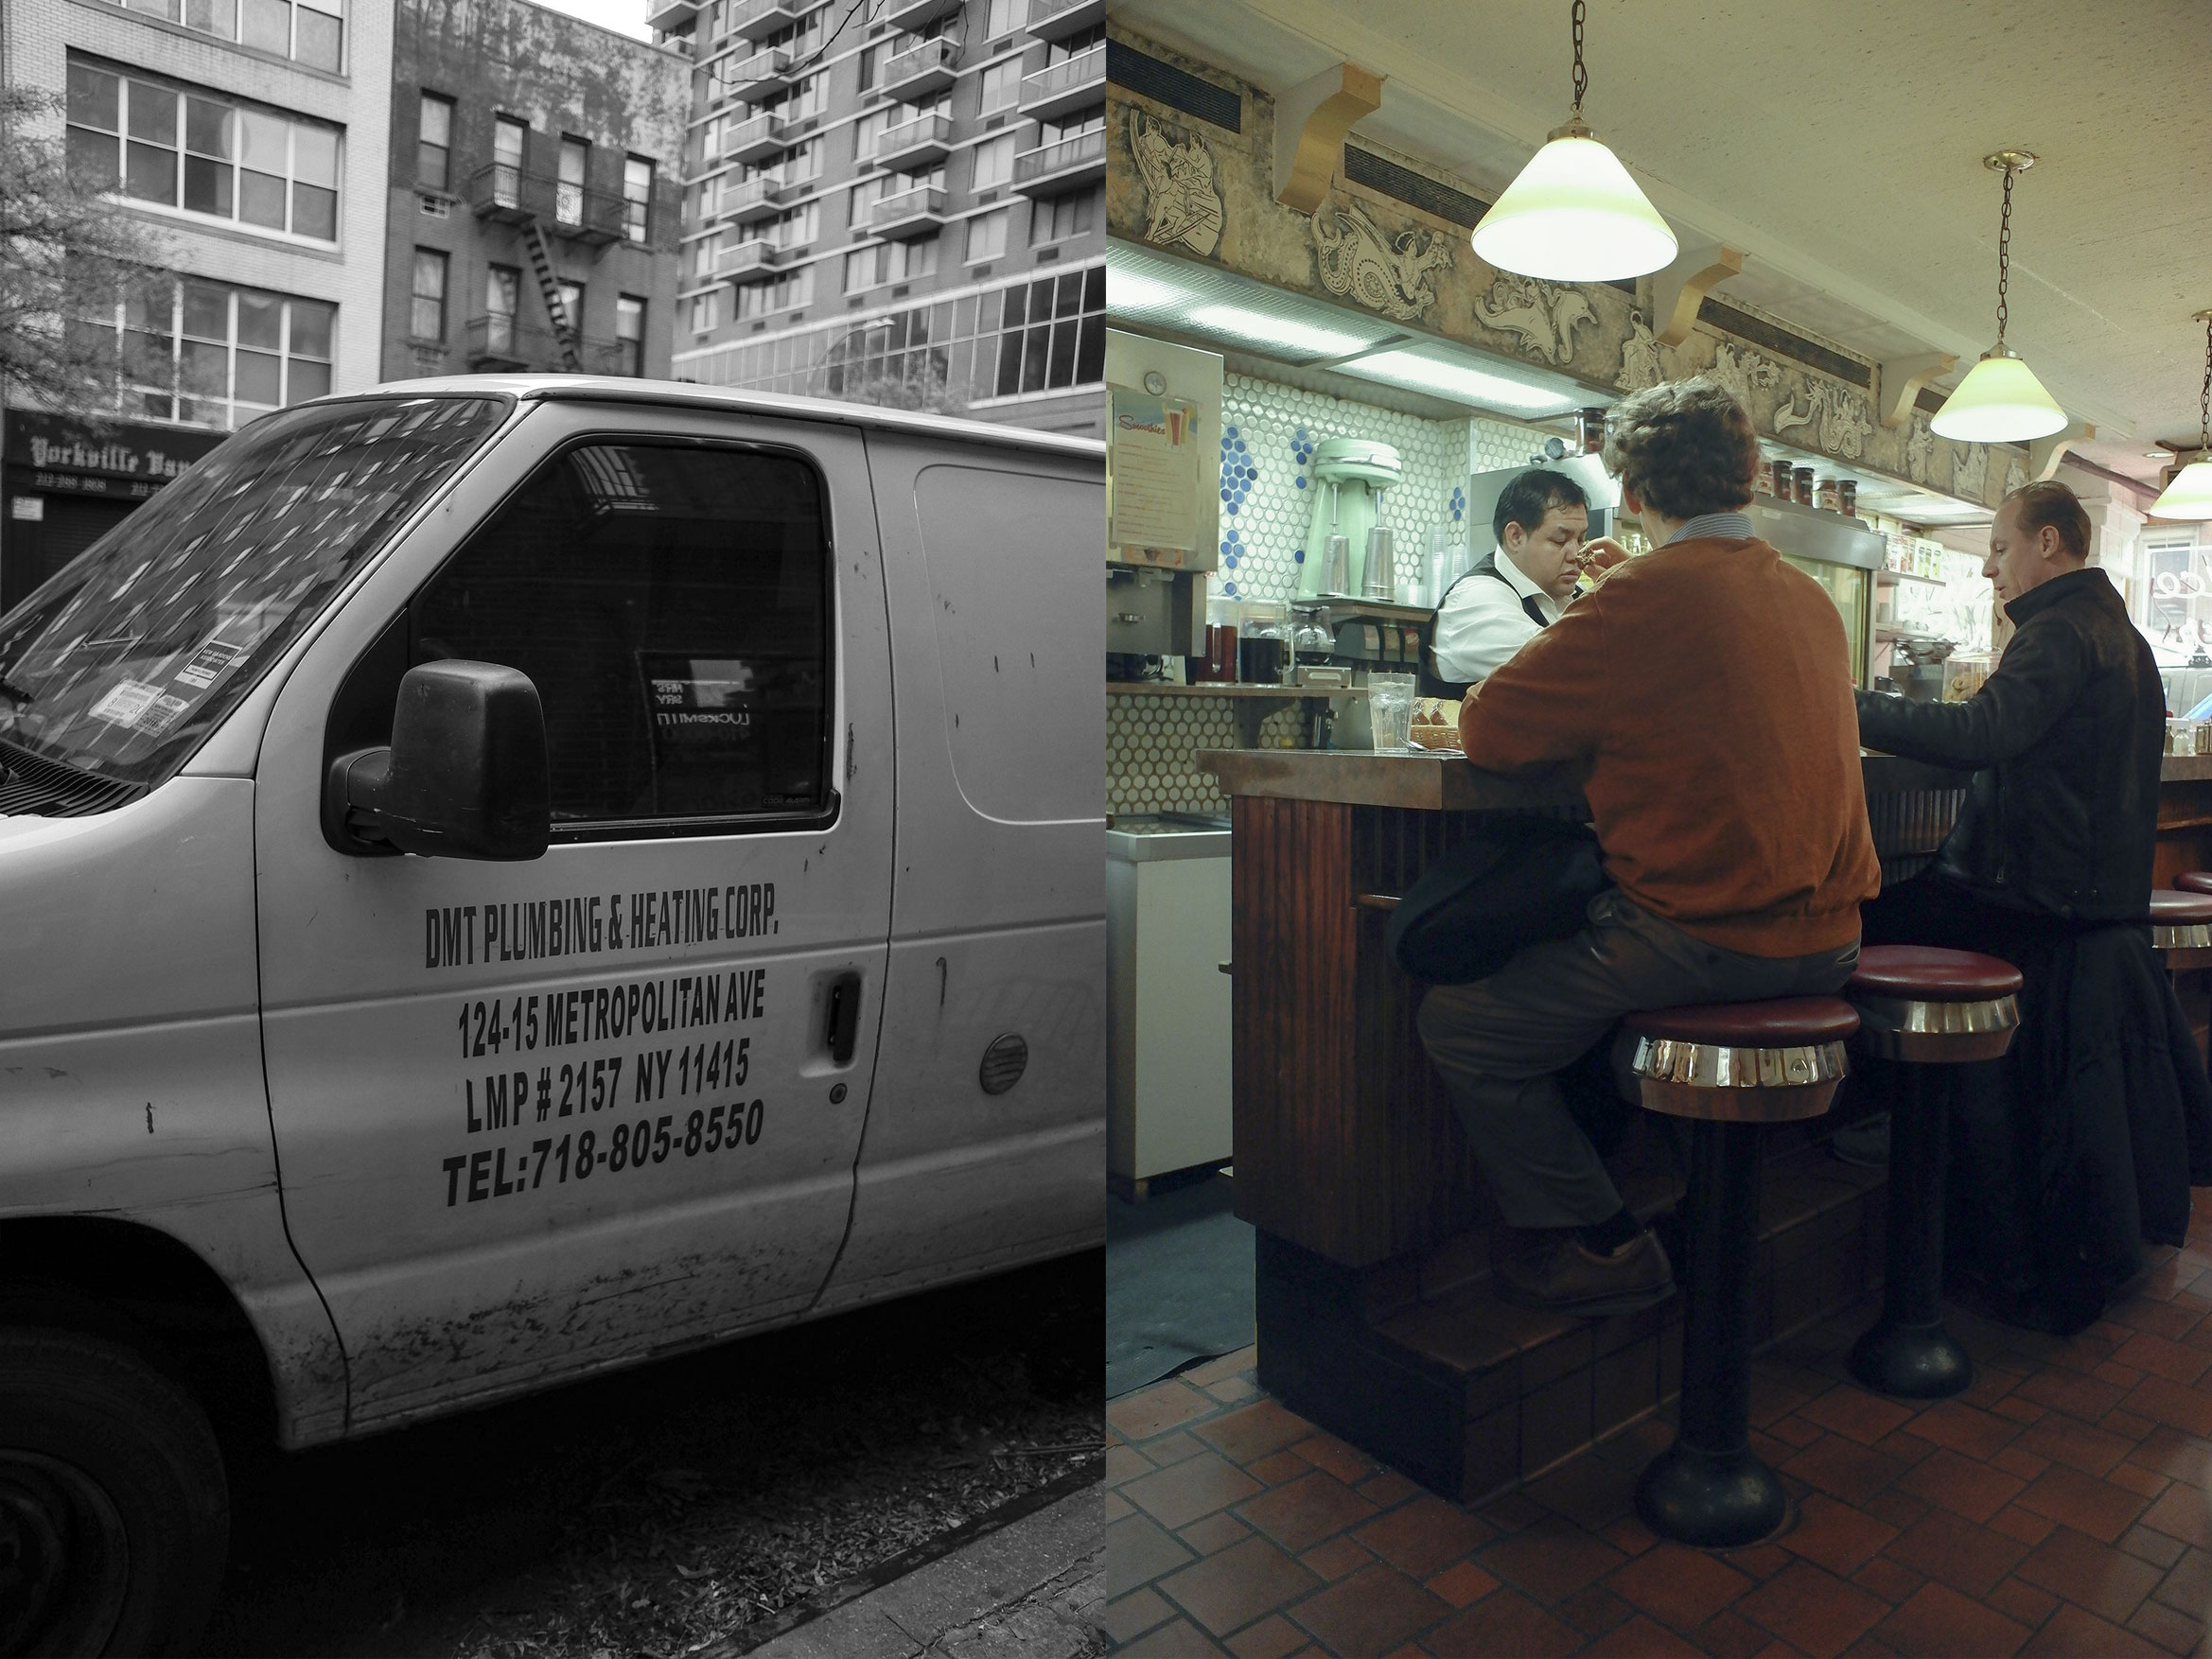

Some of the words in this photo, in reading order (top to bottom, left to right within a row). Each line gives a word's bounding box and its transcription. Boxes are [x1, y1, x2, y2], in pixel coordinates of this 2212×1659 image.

[30, 435, 140, 473] Yorkville
[1119, 414, 1166, 435] Smoothies
[426, 906, 477, 969] DMT
[484, 897, 603, 963] PLUMBING
[608, 895, 623, 950] &
[631, 887, 719, 949] HEATING
[726, 882, 779, 939] CORP.
[459, 994, 538, 1058] 124-15
[546, 973, 720, 1048] METROPOLITAN
[725, 969, 765, 1022] AVE
[465, 1071, 528, 1133] LMP
[558, 1057, 623, 1117] 2157
[635, 1049, 673, 1104] NY
[678, 1038, 750, 1095] 11415
